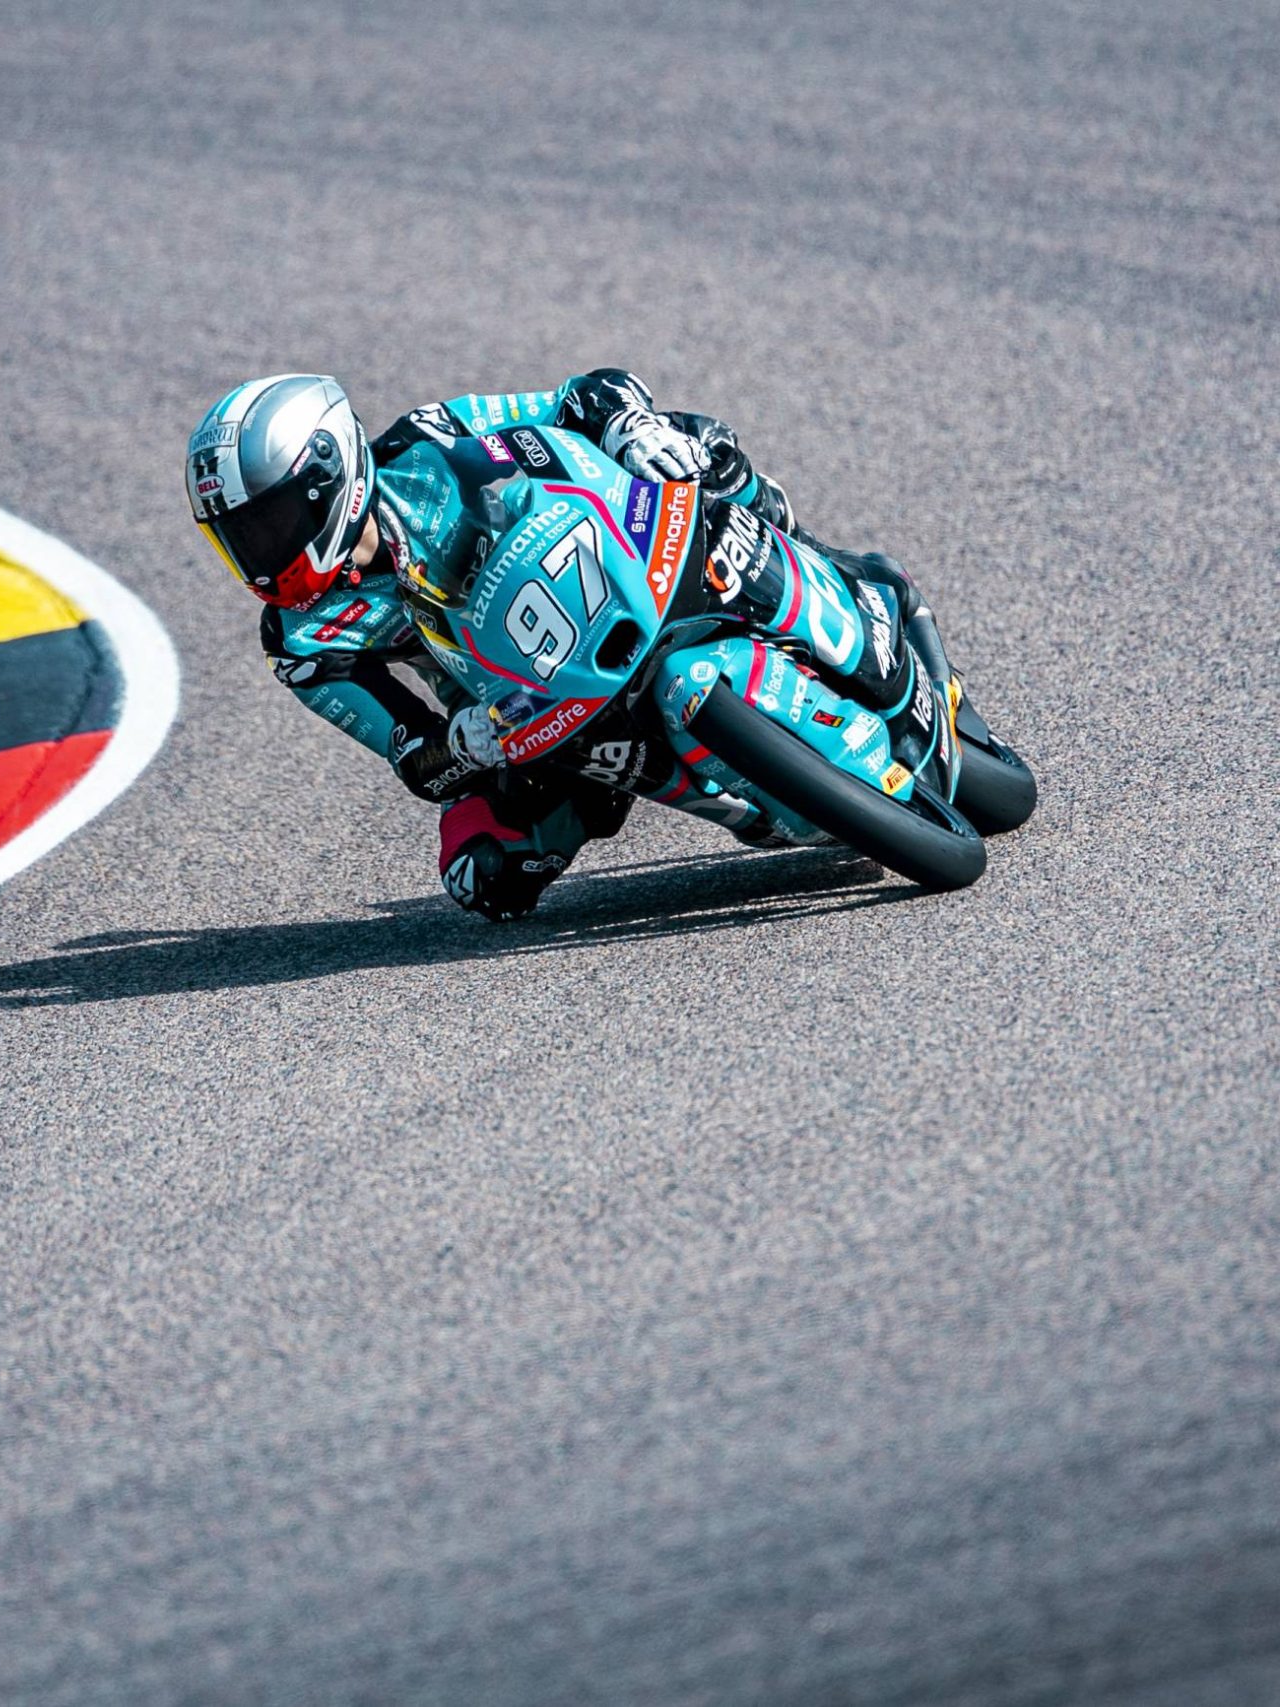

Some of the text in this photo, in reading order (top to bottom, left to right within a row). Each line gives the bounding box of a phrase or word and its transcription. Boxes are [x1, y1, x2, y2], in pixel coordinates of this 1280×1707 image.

[197, 478, 221, 496] BELL
[351, 485, 364, 516] BELL
[634, 486, 650, 521] solunion
[521, 507, 584, 568] new travel
[661, 486, 689, 561] mapfre
[472, 500, 569, 630] azulmarino
[504, 514, 612, 682] 97
[574, 600, 620, 662] azulmarino
[524, 702, 587, 752] mapfre
